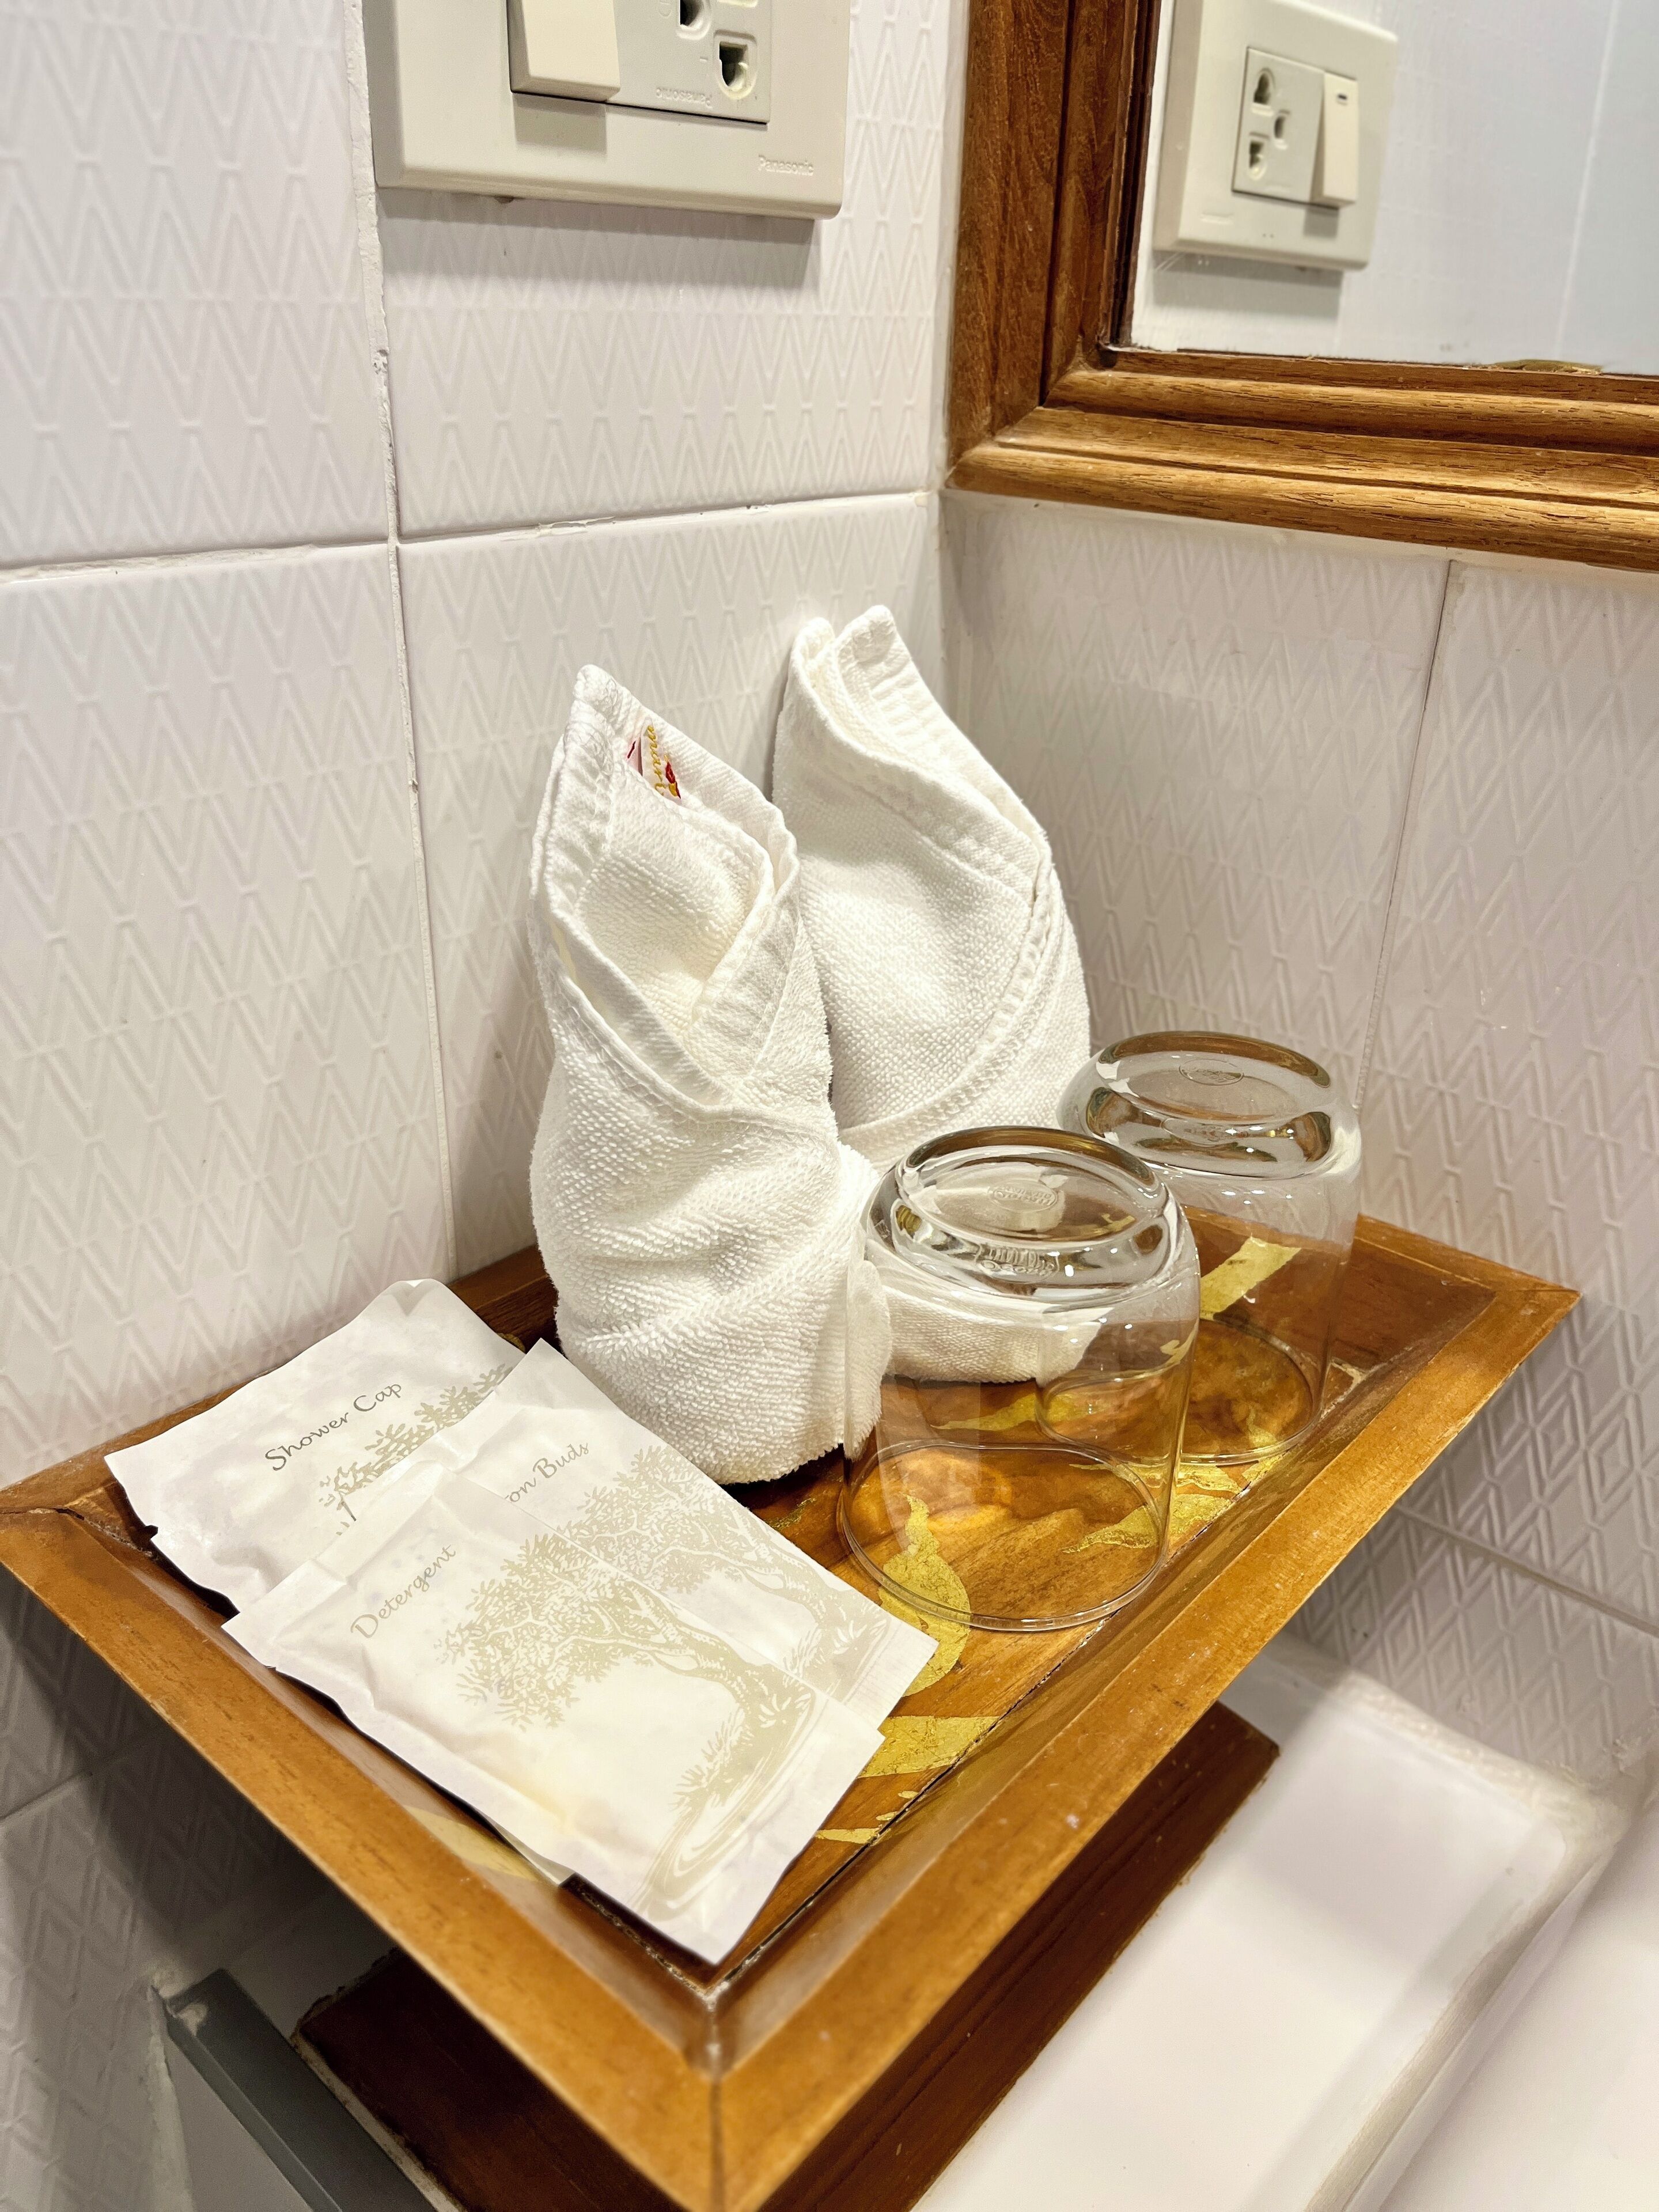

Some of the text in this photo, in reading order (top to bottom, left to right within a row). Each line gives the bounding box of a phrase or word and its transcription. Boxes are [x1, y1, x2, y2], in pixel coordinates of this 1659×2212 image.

[656, 87, 713, 109] Panasonic
[758, 154, 814, 176] Panasonic
[265, 1382, 402, 1472] Shower Cap
[533, 1441, 589, 1479] Buds
[350, 1543, 457, 1639] Detergent
